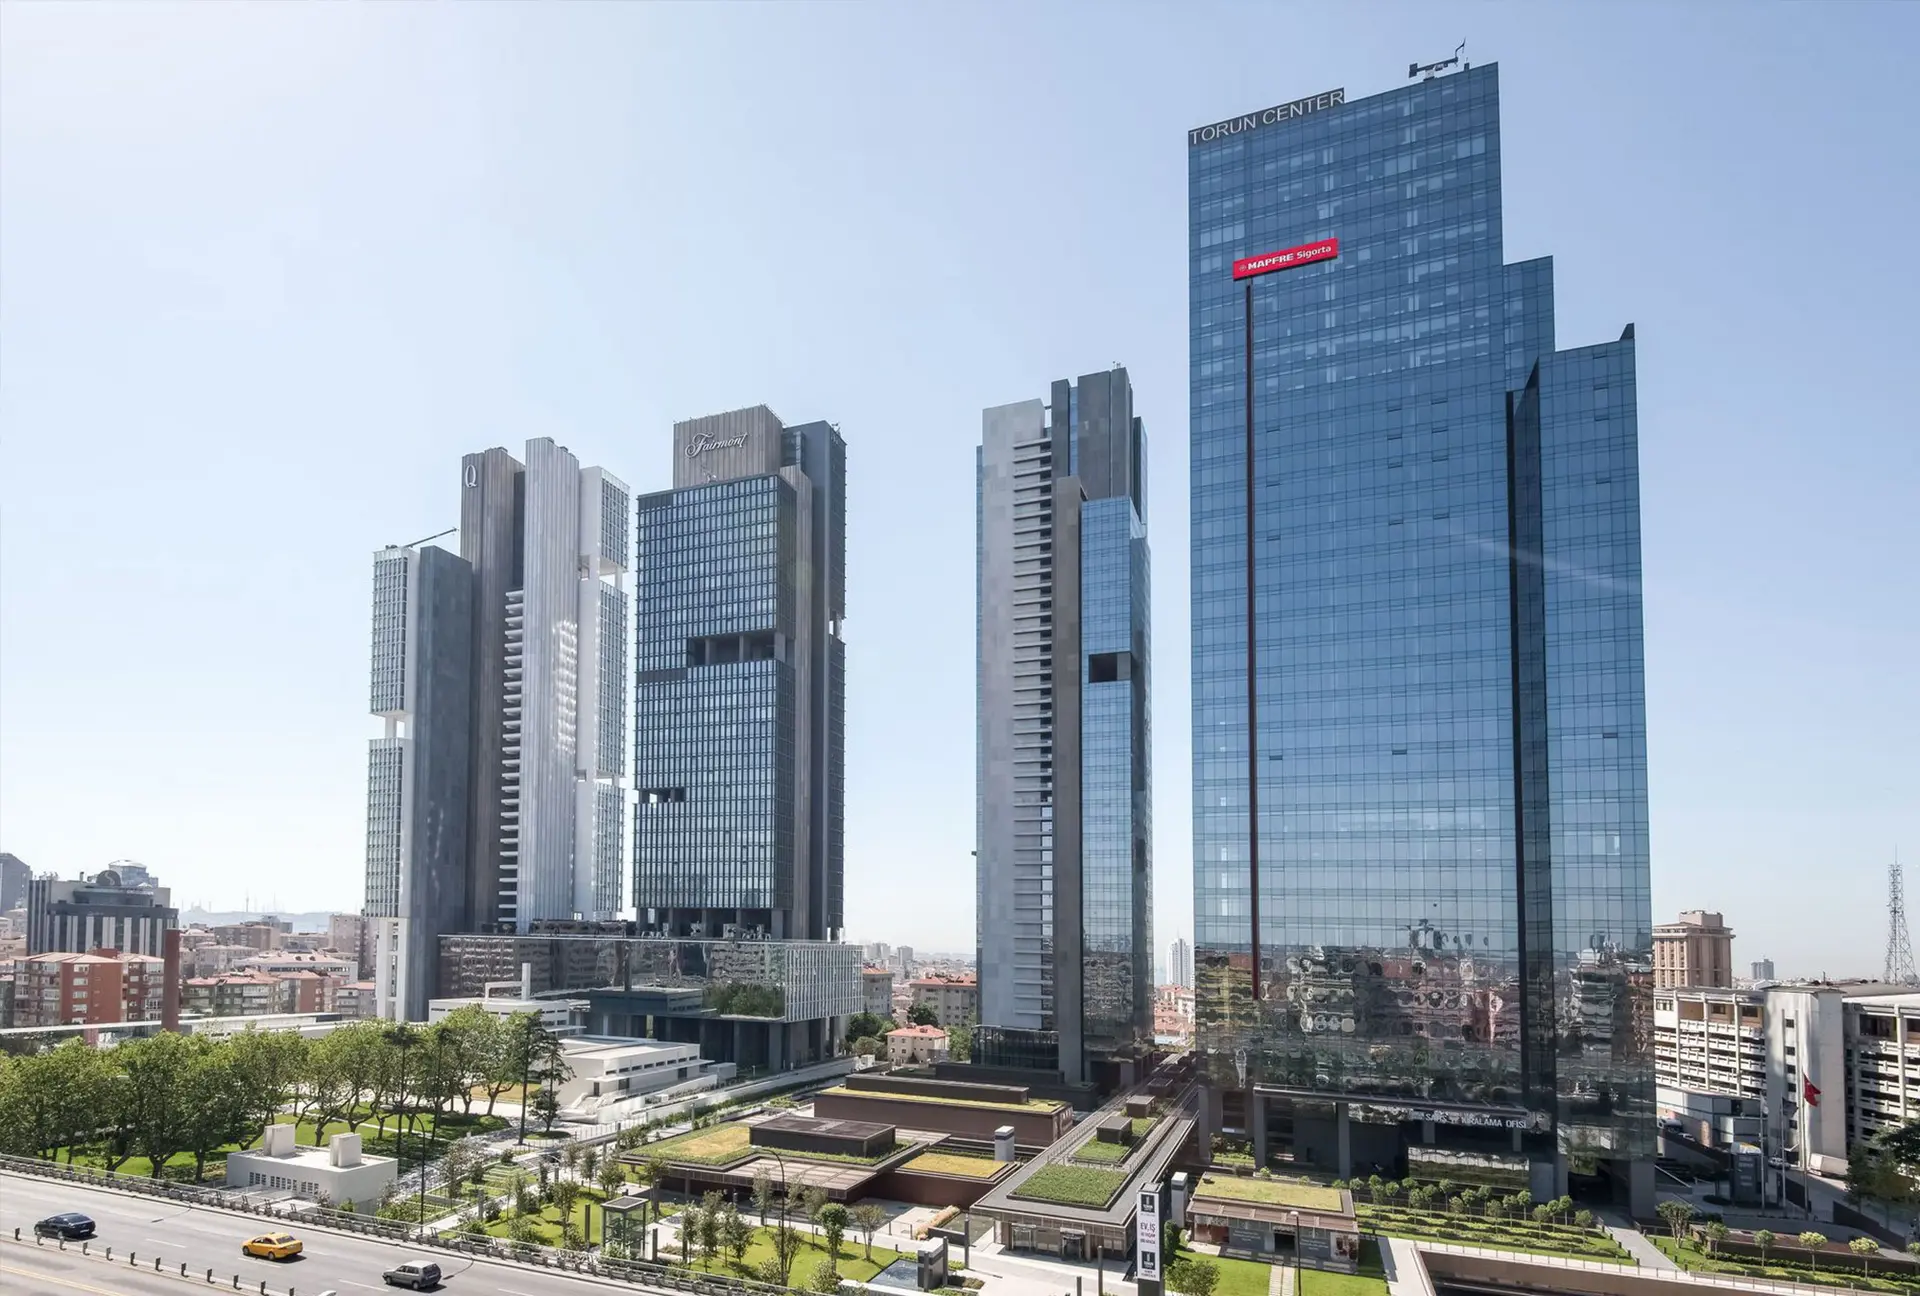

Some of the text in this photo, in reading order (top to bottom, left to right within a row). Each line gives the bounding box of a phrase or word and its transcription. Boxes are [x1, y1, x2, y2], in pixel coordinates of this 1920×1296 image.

[1190, 90, 1344, 145] TORUN CENTER
[1247, 245, 1332, 271] MAPFRE Sigorta
[684, 431, 748, 458] Fairmont
[465, 464, 477, 488] Q
